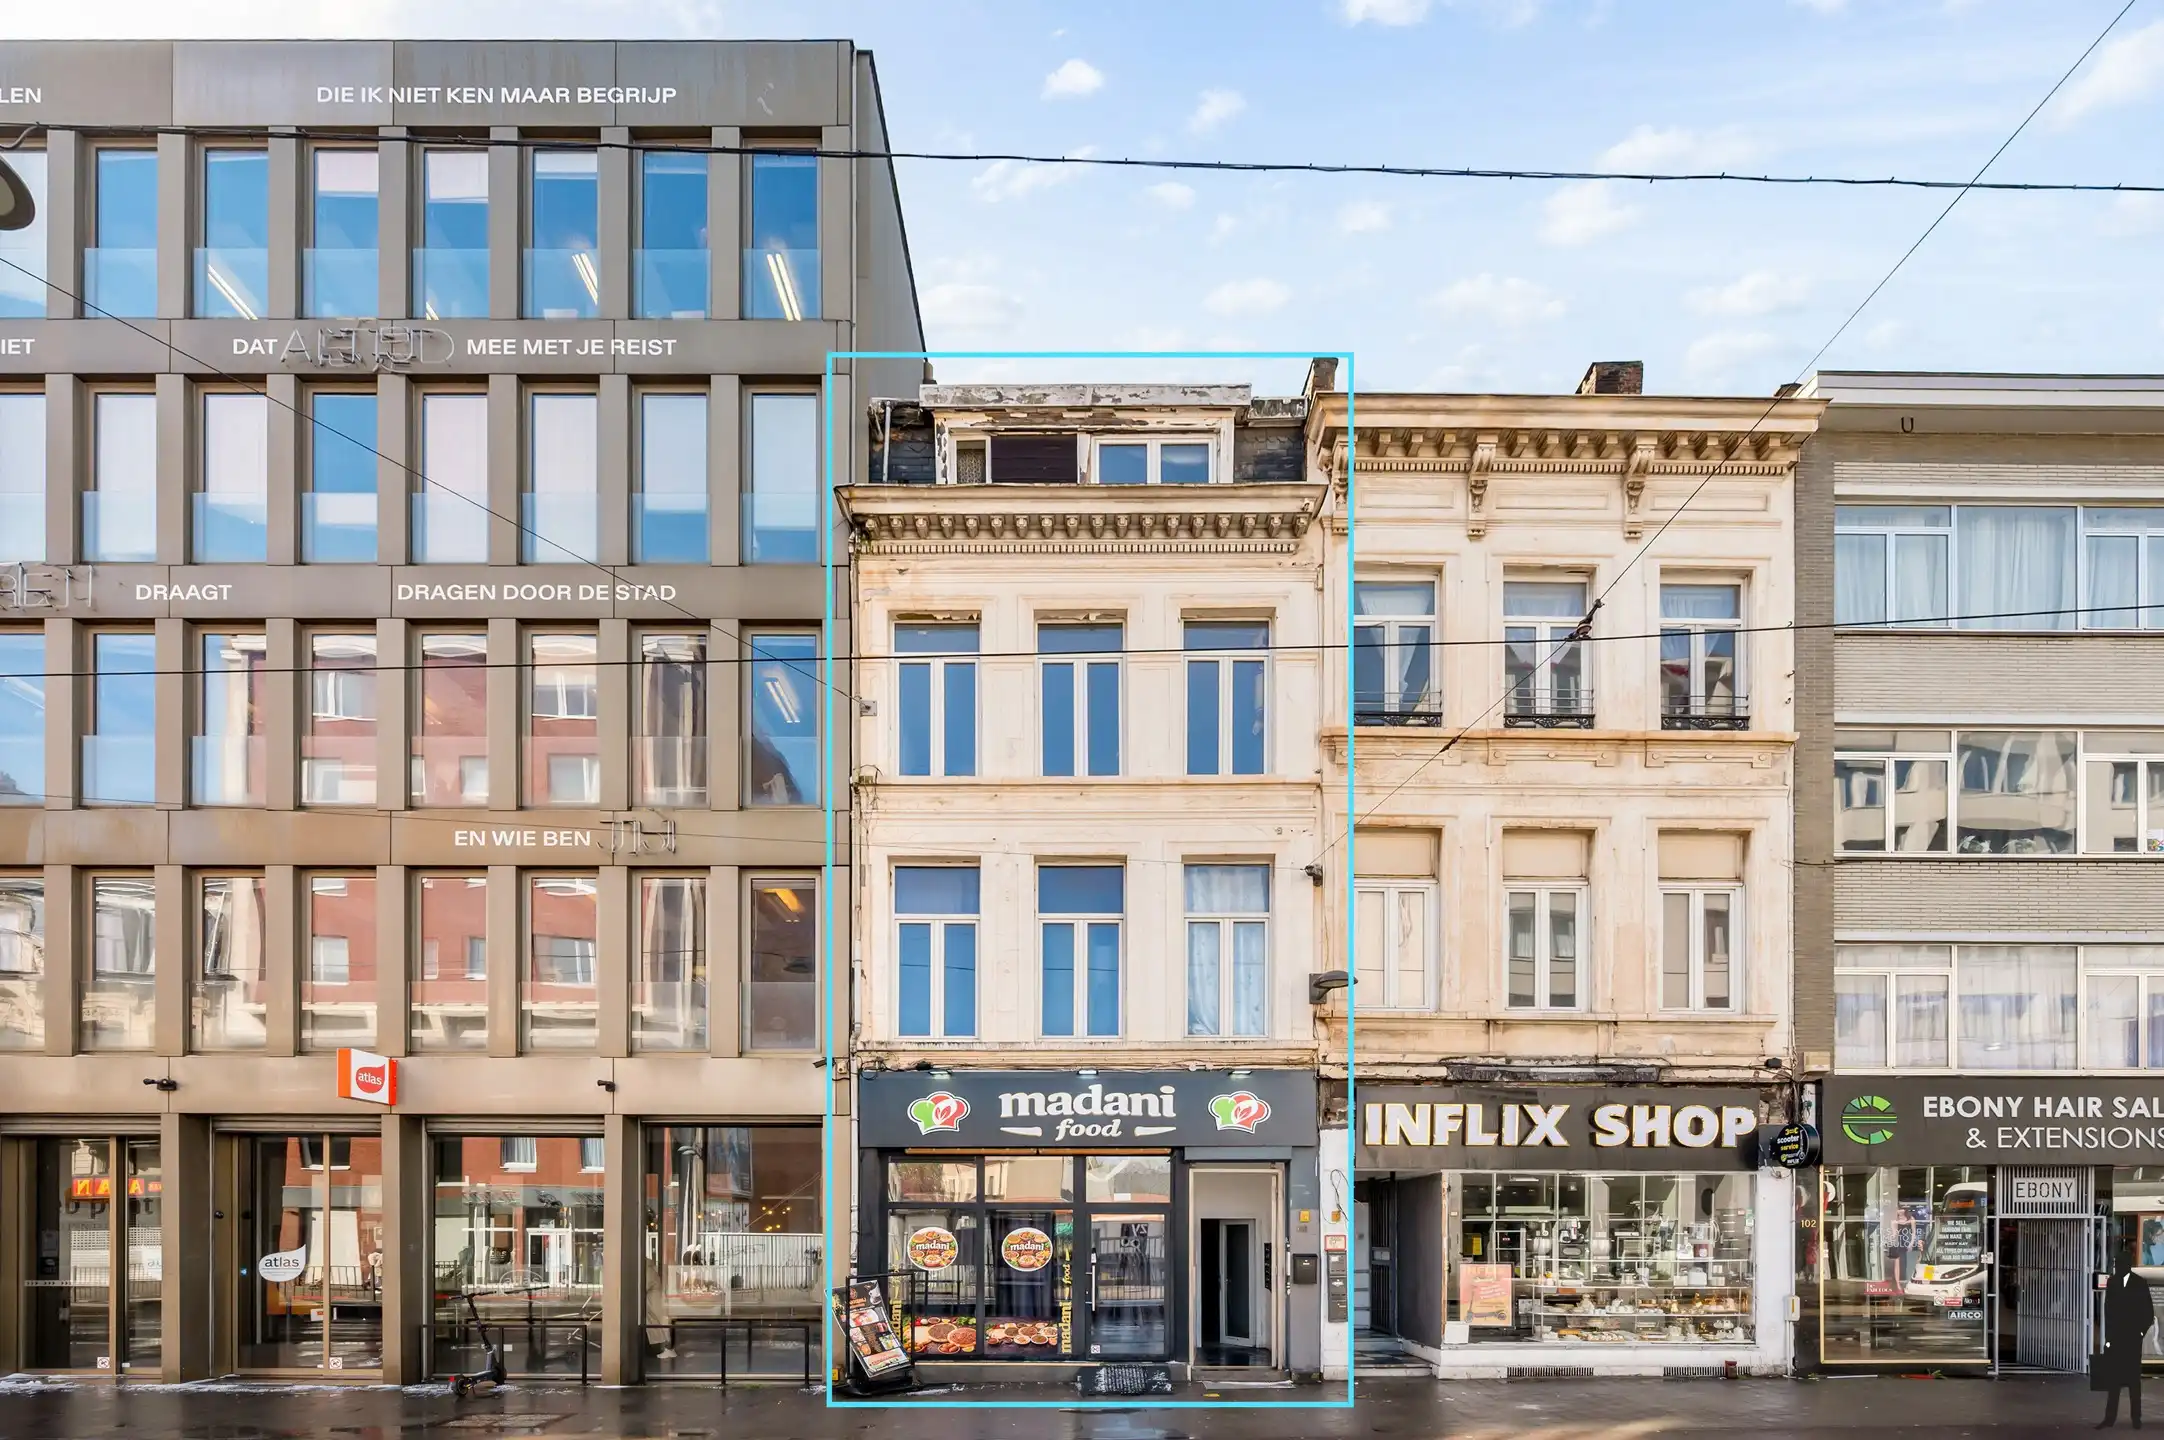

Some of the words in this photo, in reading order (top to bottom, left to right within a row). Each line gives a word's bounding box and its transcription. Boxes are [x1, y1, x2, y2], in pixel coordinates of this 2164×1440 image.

[316, 87, 354, 103] DIE
[361, 87, 383, 103] IK
[389, 87, 441, 103] NIET
[447, 87, 494, 103] KEN
[501, 87, 570, 103] MAAR
[577, 87, 677, 104] BEGRIJP
[232, 338, 278, 355] DAT
[467, 338, 517, 355] MEE
[523, 338, 573, 355] MET
[576, 338, 604, 355] JE
[611, 338, 677, 355] REIST
[135, 584, 232, 600] DRAAGT
[397, 584, 496, 600] DRAGEN
[503, 584, 572, 601] DOOR
[578, 584, 609, 600] DE
[615, 584, 677, 601] STAD
[454, 830, 486, 846] EN
[491, 830, 536, 846] WIE
[543, 830, 590, 846] BEN
[358, 1072, 382, 1086] atlas
[999, 1084, 1177, 1118] madani
[1923, 1096, 2024, 1118] EBONY
[2033, 1096, 2102, 1118] HAIR
[2112, 1096, 2164, 1118] SAL
[1055, 1118, 1122, 1141] food
[1364, 1103, 1570, 1147] INFLIX
[1593, 1104, 1757, 1148] SHOP
[1777, 1135, 1800, 1144] scooter
[1965, 1127, 1986, 1148] &
[2015, 1181, 2075, 1199] EBONY
[1800, 1219, 1817, 1228] 102
[916, 1240, 950, 1250] madani
[1010, 1241, 1045, 1251] madani
[265, 1257, 299, 1267] atlas
[1063, 1263, 1072, 1284] food
[1950, 1311, 1981, 1319] AIRCO
[1059, 1301, 1072, 1354] madani
